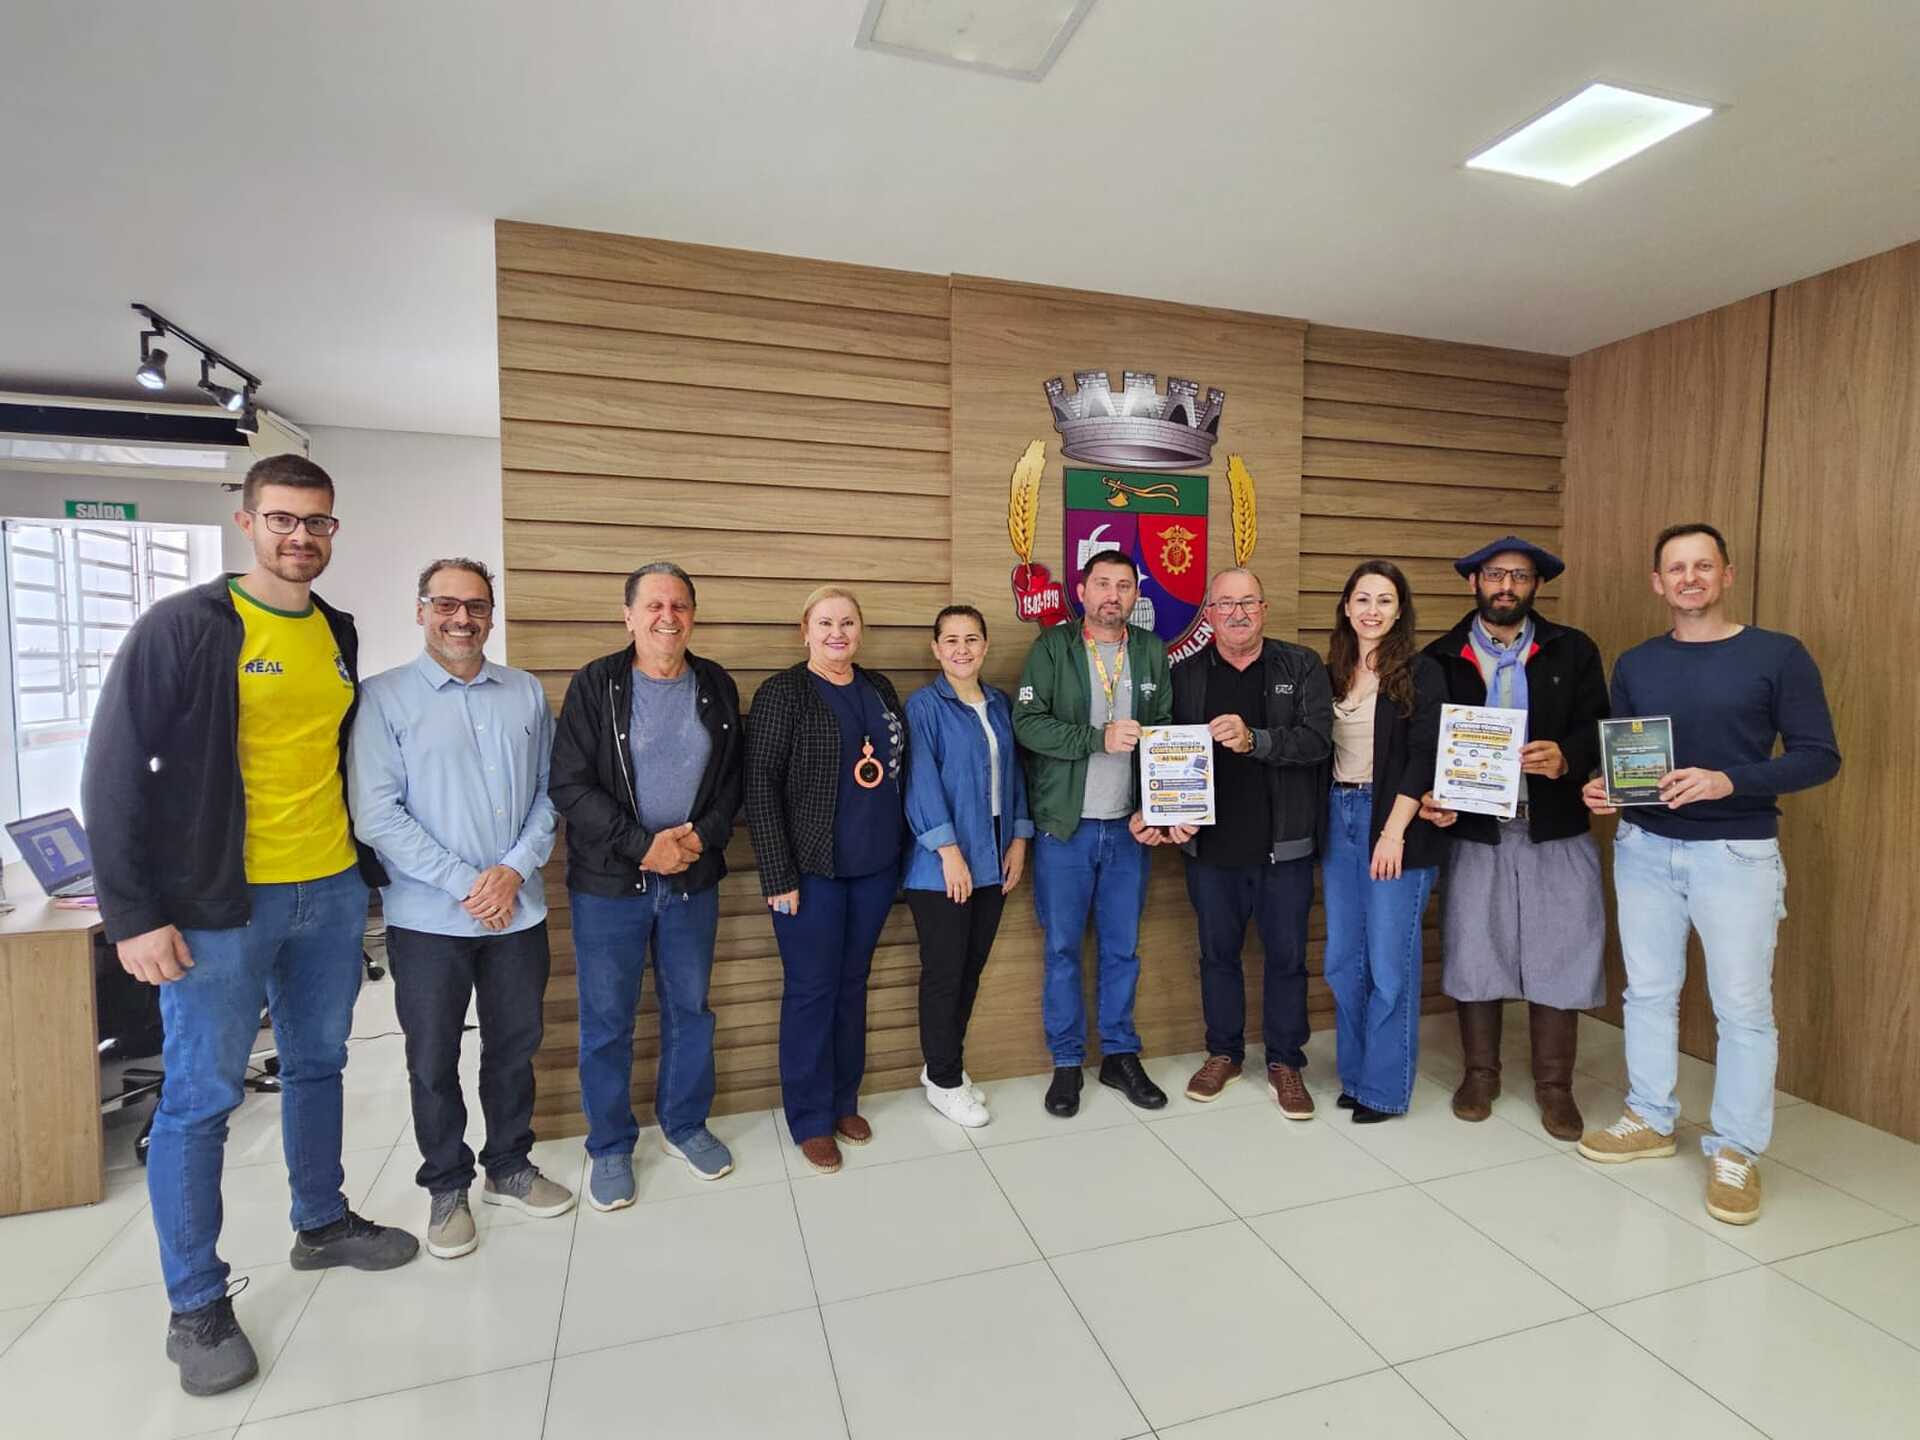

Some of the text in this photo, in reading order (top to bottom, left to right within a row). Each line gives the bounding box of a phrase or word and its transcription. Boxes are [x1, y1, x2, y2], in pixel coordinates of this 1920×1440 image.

[75, 501, 126, 520] SAÍDA
[1167, 621, 1215, 669] PHALEN
[244, 661, 284, 673] REAL
